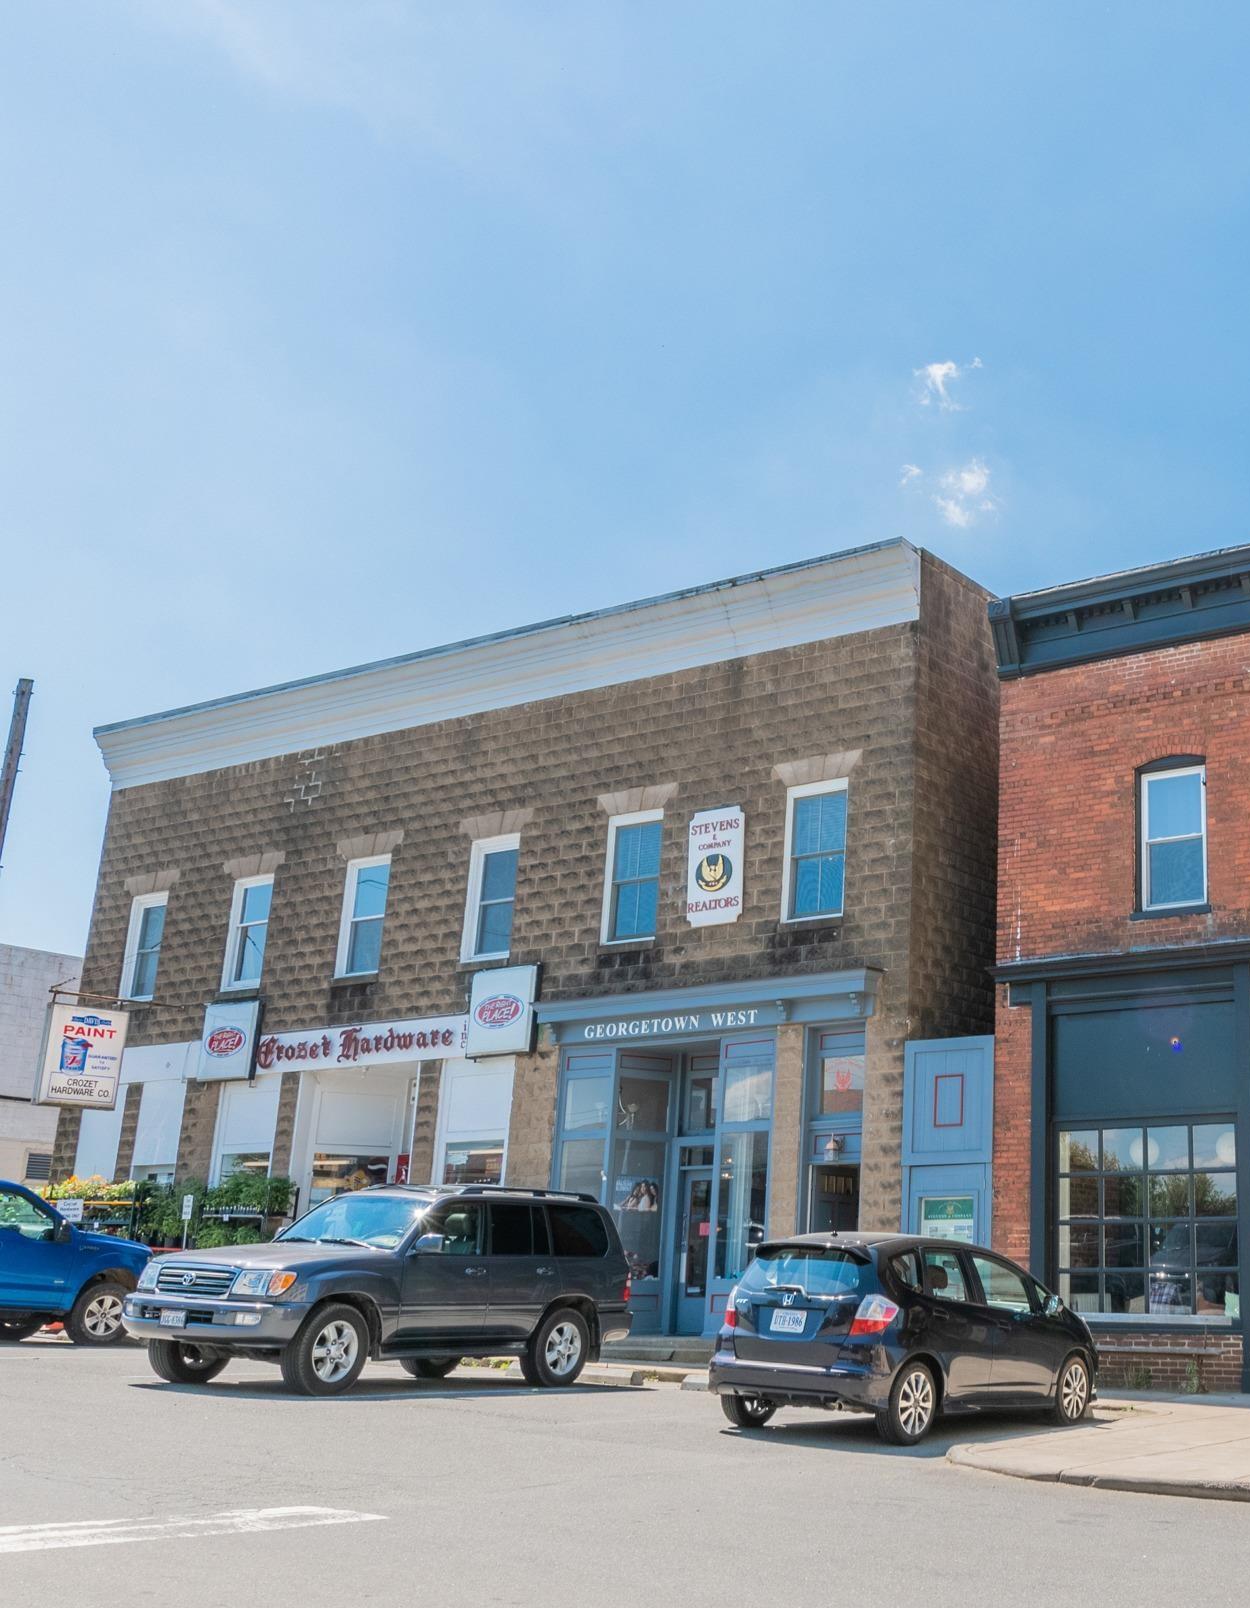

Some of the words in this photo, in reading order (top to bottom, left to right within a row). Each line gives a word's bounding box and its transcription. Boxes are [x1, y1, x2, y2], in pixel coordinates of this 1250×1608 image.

[691, 818, 740, 836] STEVENS
[698, 839, 732, 851] COMPANY
[687, 896, 740, 914] REALTORS
[63, 1025, 117, 1039] PAINT
[584, 1014, 700, 1039] GEORGETOWN
[711, 1009, 758, 1027] WEST
[256, 1034, 331, 1069] Crozet
[336, 1027, 454, 1063] Hardware
[67, 1078, 98, 1088] CROZET
[50, 1086, 94, 1097] HARDWARE
